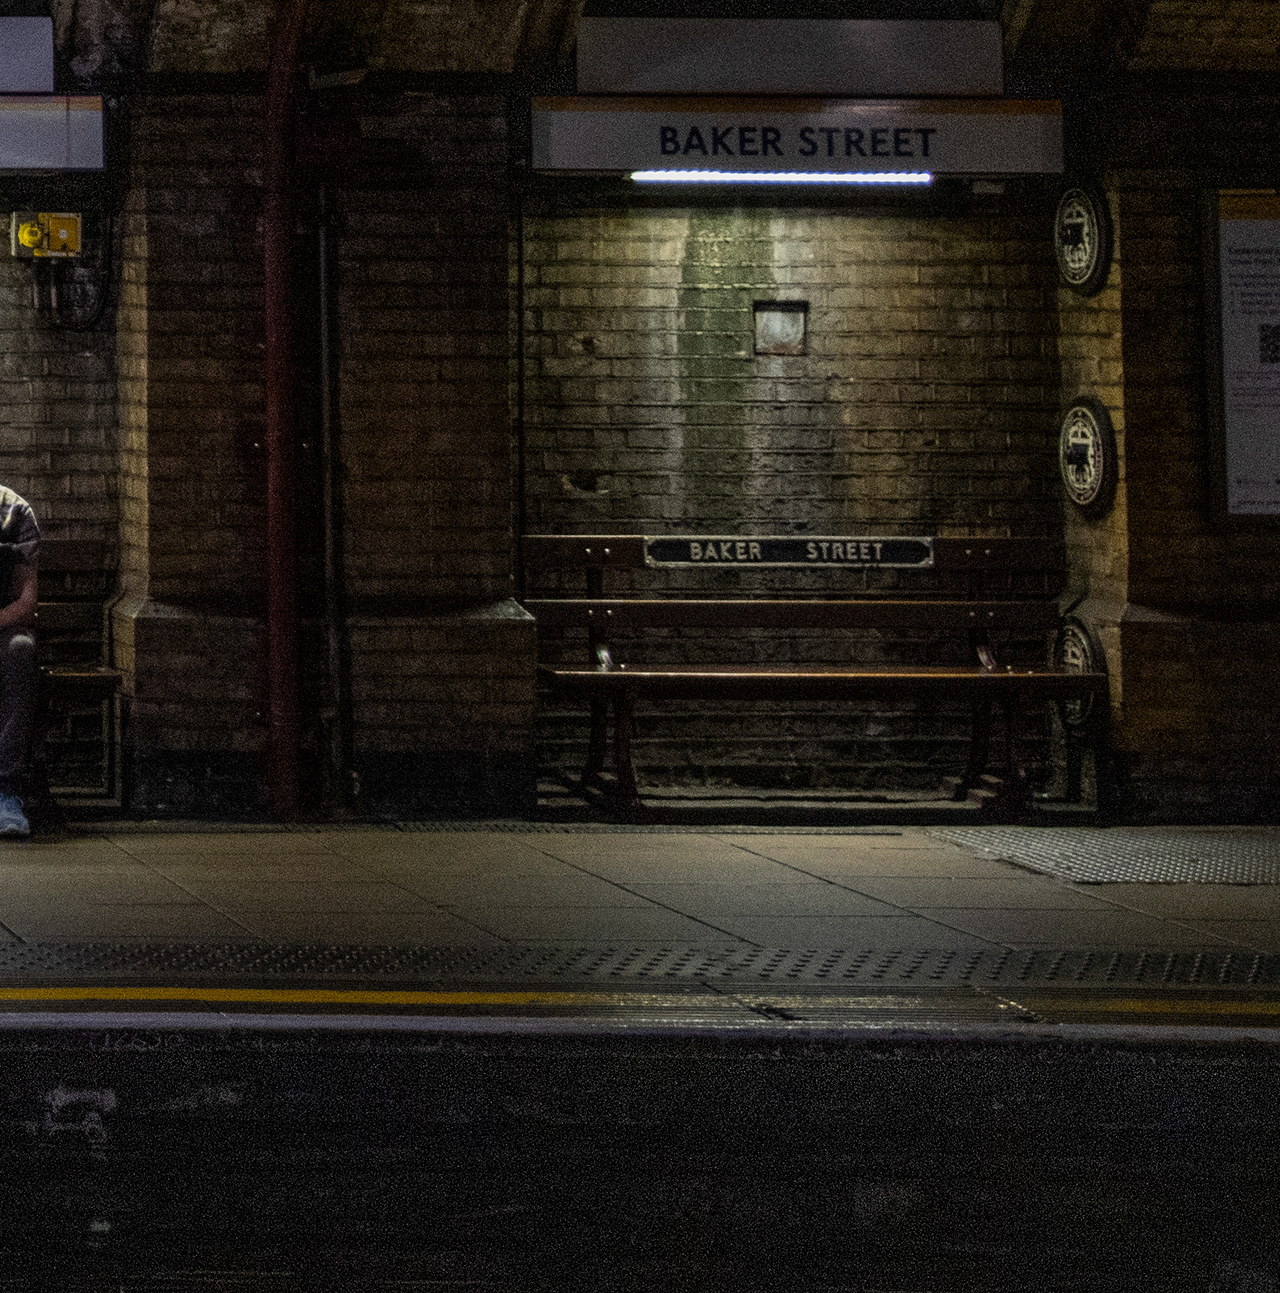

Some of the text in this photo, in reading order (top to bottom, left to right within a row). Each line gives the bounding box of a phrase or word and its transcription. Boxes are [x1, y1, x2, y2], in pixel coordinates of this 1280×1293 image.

[659, 126, 937, 158] BAKER STREET
[690, 541, 883, 561] BAKER STREET
